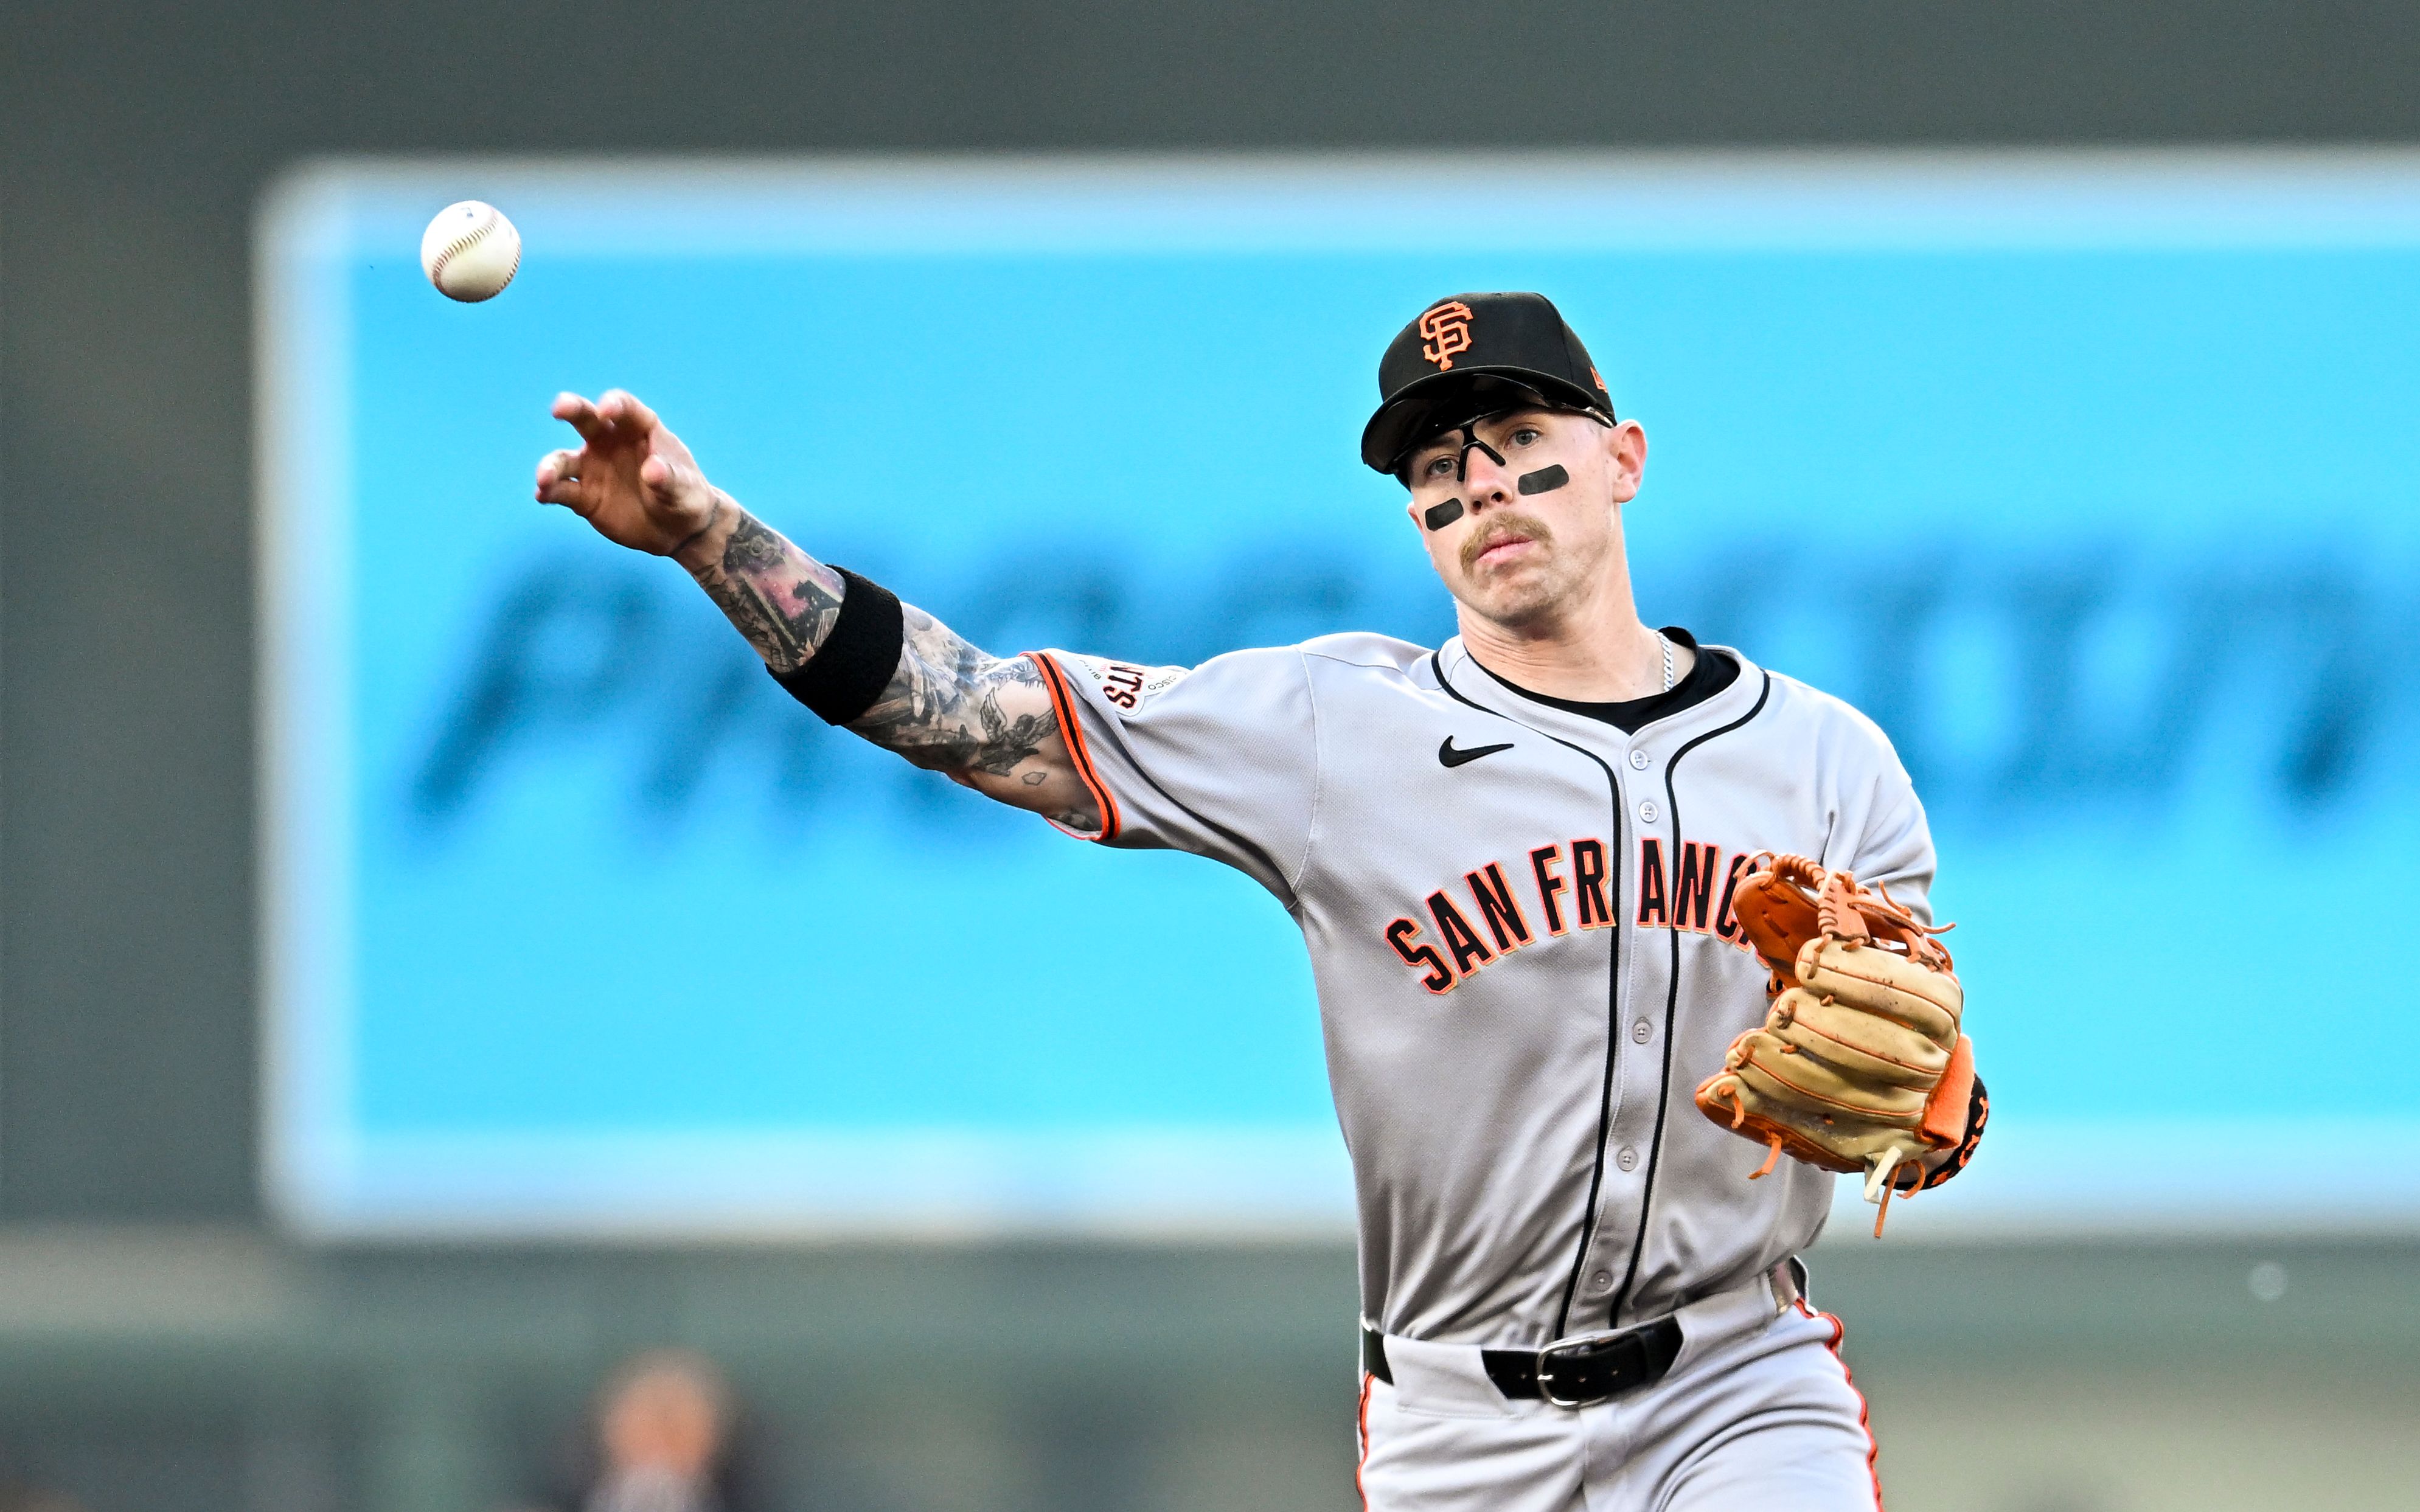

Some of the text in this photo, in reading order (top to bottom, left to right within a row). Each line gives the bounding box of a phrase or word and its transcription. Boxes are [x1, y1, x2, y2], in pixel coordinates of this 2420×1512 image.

[1419, 300, 1473, 372] SF
[1385, 837, 1772, 994] SAN FRANC
